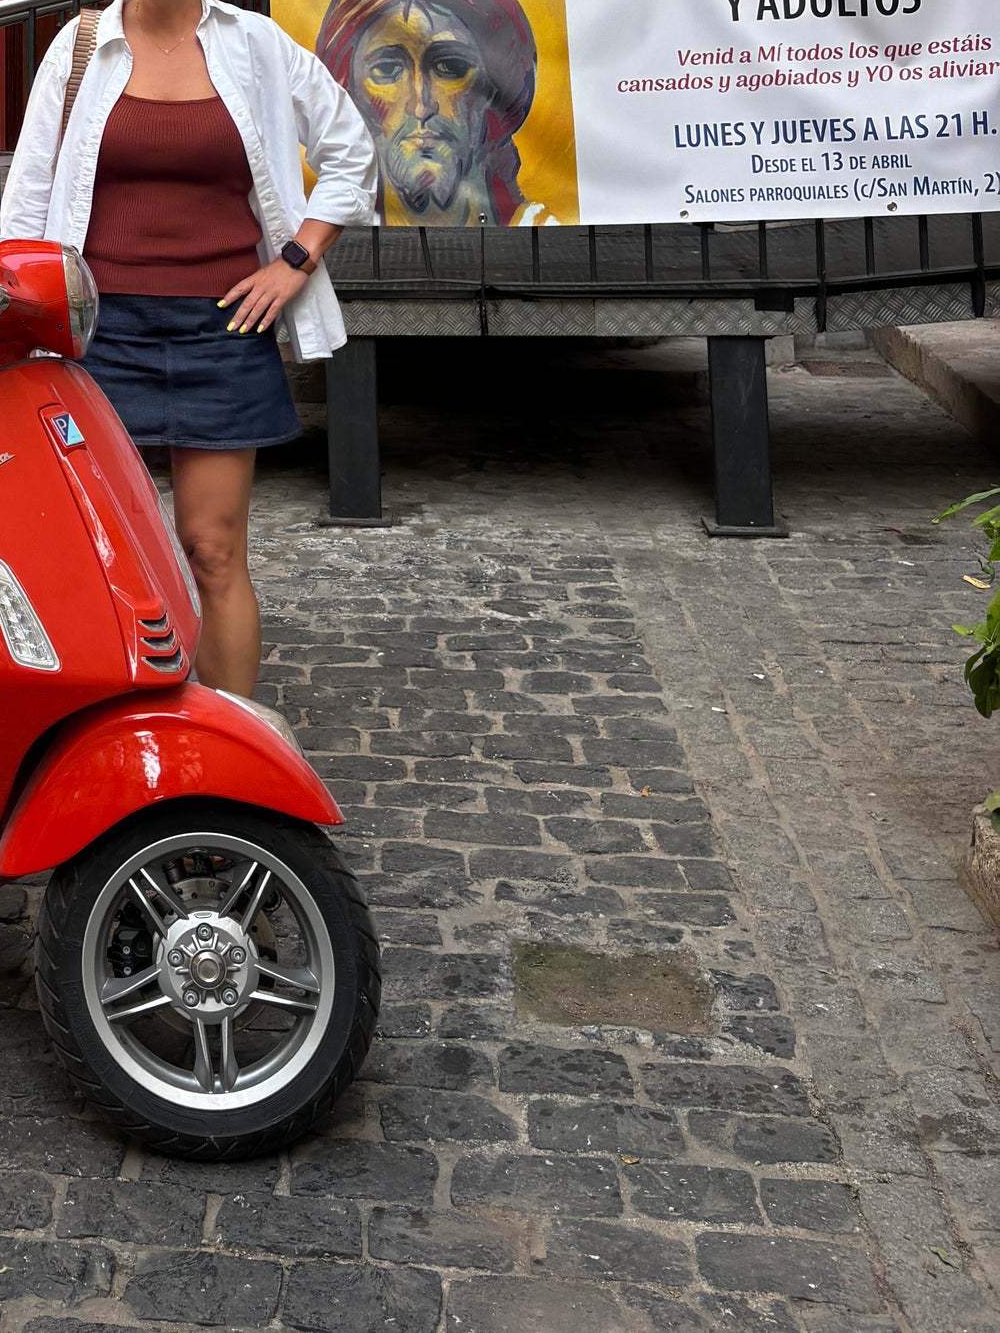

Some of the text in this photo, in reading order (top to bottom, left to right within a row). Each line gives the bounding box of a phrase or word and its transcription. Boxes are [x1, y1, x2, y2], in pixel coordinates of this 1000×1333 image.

[677, 47, 734, 66] Venid
[739, 50, 751, 64] a
[787, 44, 843, 61] todos
[850, 42, 879, 58] los
[884, 42, 922, 62] que
[928, 33, 992, 55] estáis
[617, 73, 714, 93] cansados
[718, 75, 731, 93] y
[736, 67, 842, 92] agobiados
[848, 70, 860, 87] y
[866, 64, 893, 82] YO
[899, 66, 923, 80] os
[674, 111, 997, 148] LUNES Y JUEVES A LAS 21 H.
[821, 151, 843, 171] 13
